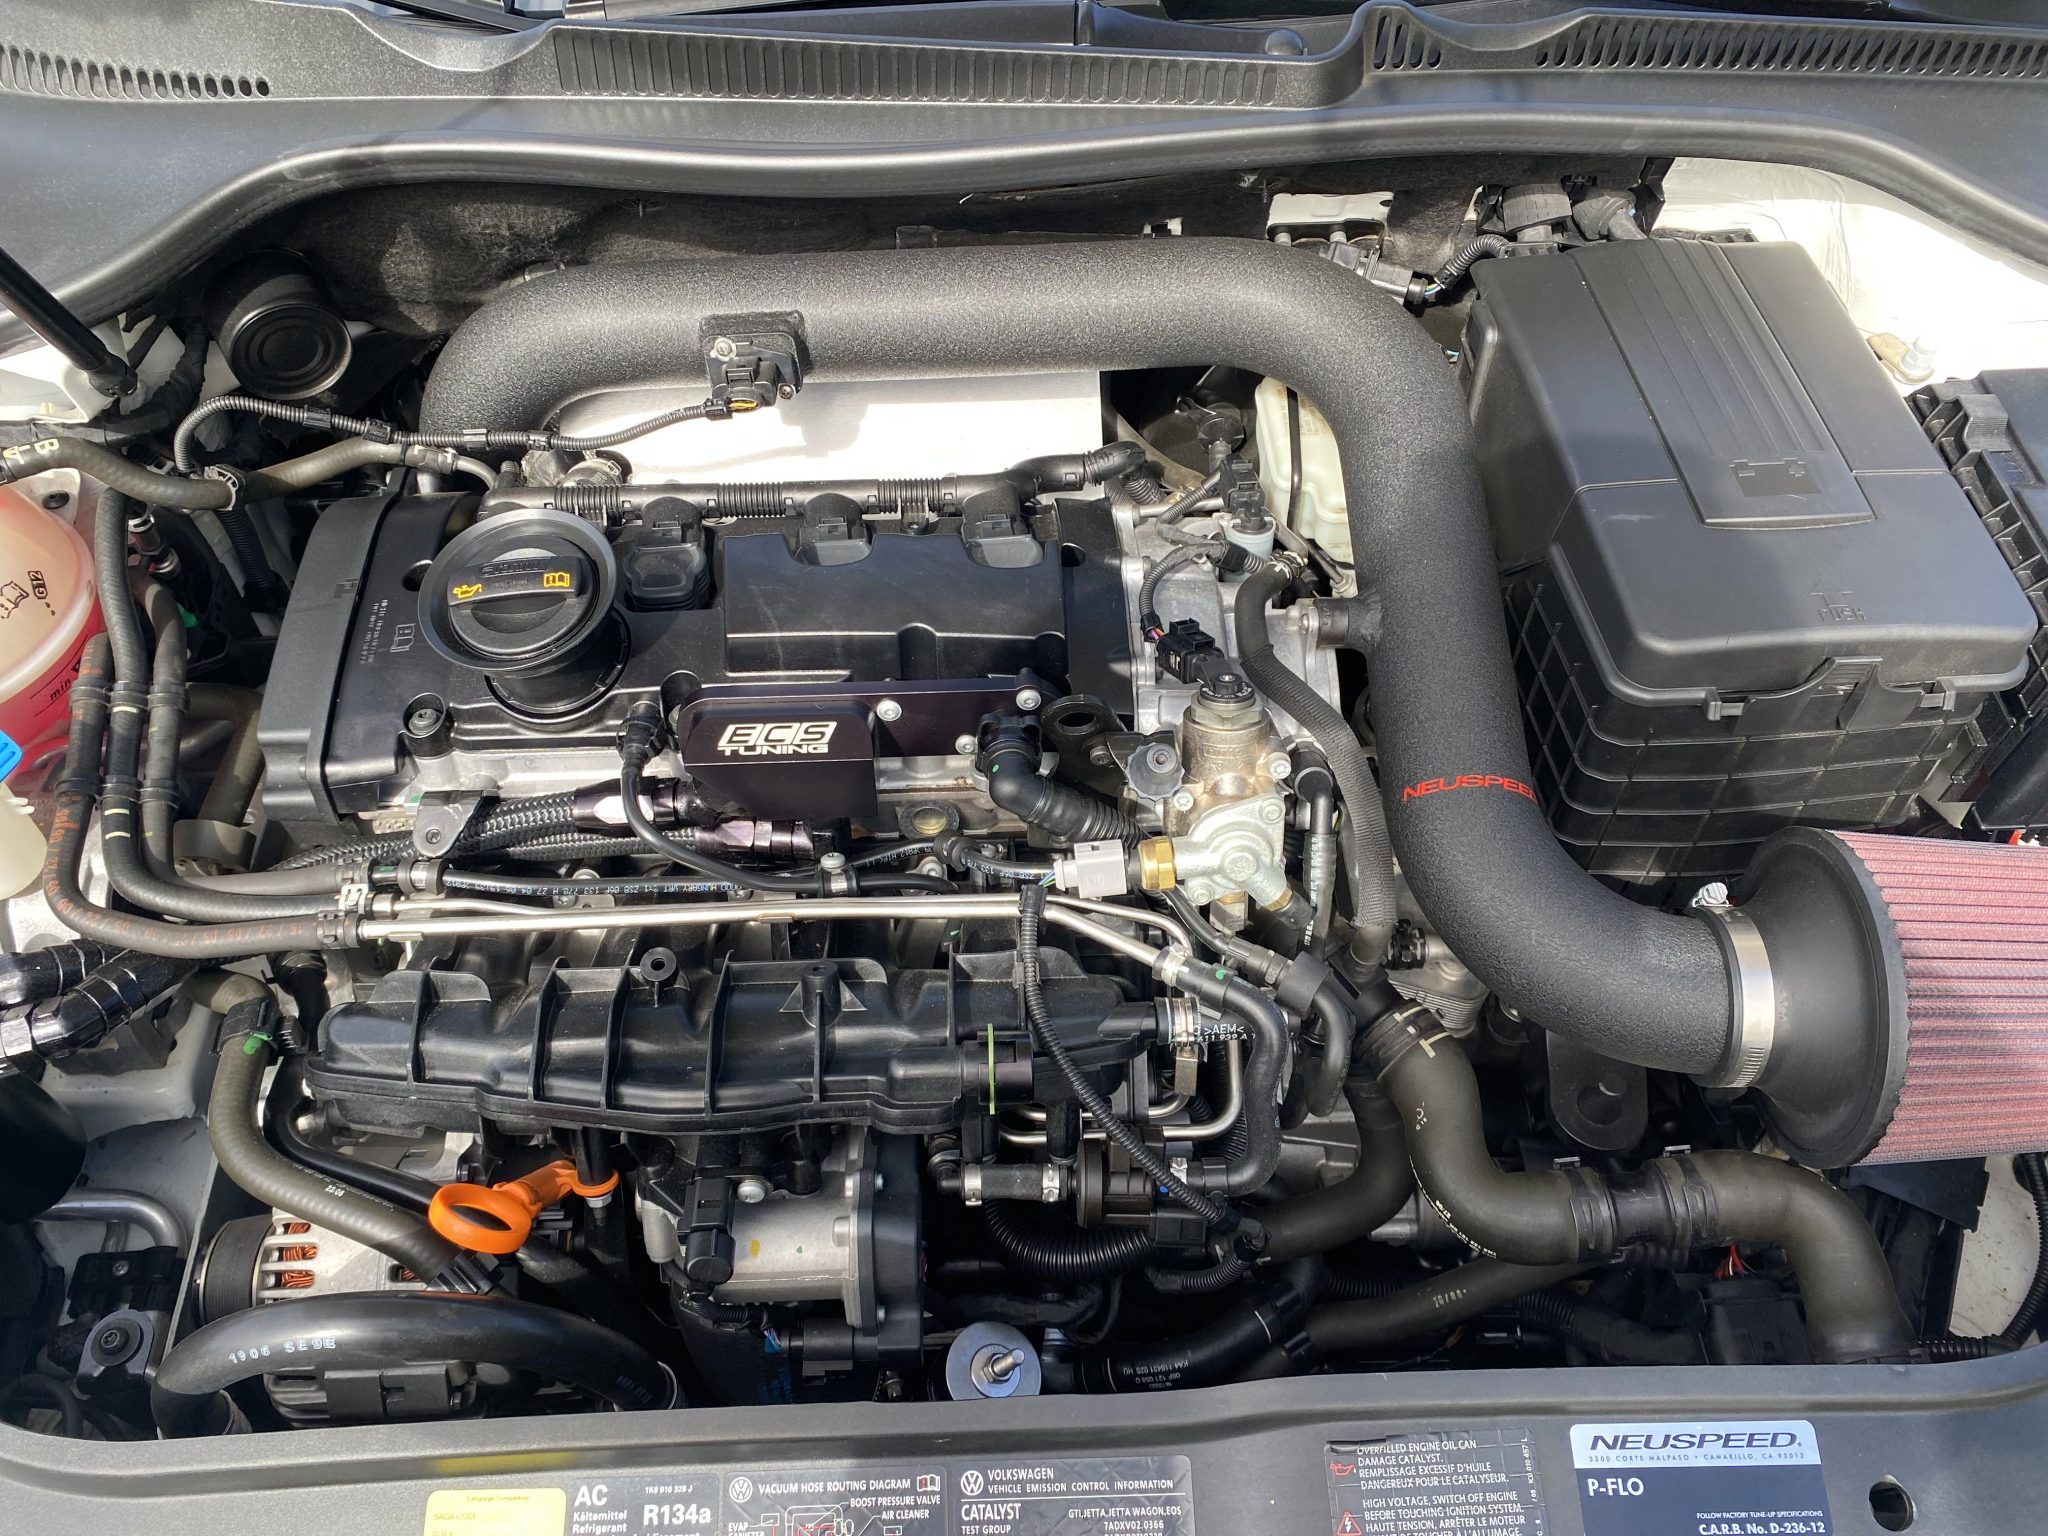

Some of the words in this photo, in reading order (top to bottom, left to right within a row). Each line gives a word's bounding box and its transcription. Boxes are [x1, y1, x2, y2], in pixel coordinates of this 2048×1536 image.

[30, 572, 46, 597] G12
[1817, 607, 1866, 621] PUSH
[50, 678, 70, 700] min
[718, 721, 838, 747] ECS
[718, 744, 829, 756] TUNING
[1356, 1443, 1407, 1455] OVERFILLED
[1408, 1441, 1441, 1452] ENGINE
[1442, 1440, 1458, 1450] OIL
[1458, 1440, 1477, 1450] CAN
[1358, 1455, 1398, 1466] DAMAGE
[1398, 1453, 1444, 1464] CATALYST.
[1616, 1454, 1644, 1462] CORTE
[987, 1468, 1054, 1481] VOLKSWAGEN
[1360, 1466, 1416, 1478] REMPLISSAGE
[1418, 1464, 1455, 1475] EXCESSIF
[1457, 1462, 1492, 1473] D'HUILE
[688, 1484, 693, 1492] J
[758, 1482, 798, 1494] VACUUM
[801, 1482, 824, 1493] HOSE
[826, 1480, 866, 1492] ROUTING
[870, 1478, 911, 1490] DIAGRAM
[988, 1484, 1022, 1494] VEHICLE
[1026, 1482, 1067, 1492] EMISSION
[1072, 1482, 1110, 1492] CONTROL
[1114, 1480, 1174, 1490] INFORMATION
[1361, 1478, 1414, 1490] DANGEREUX
[1416, 1476, 1440, 1487] POUR
[1441, 1475, 1452, 1486] LE
[1452, 1473, 1509, 1485] CATALYSEUR.
[1587, 1478, 1645, 1496] P-FLO
[574, 1484, 609, 1507] AC
[850, 1497, 876, 1508] BOOST
[878, 1496, 916, 1507] PRESSURE
[916, 1494, 940, 1505] VALVE
[1362, 1498, 1386, 1508] HIGH
[1388, 1496, 1430, 1507] VOLTAGE,
[1432, 1494, 1466, 1504] SWITCH
[1468, 1492, 1484, 1502] OFF
[1486, 1491, 1518, 1502] ENGINE
[573, 1510, 628, 1522] Kältemittel
[643, 1503, 712, 1526] R134a
[881, 1510, 895, 1520] AIR
[896, 1509, 930, 1520] CLEANER
[961, 1503, 1021, 1521] CATALYST
[1132, 1506, 1182, 1516] WAGON,EOS
[1364, 1510, 1396, 1520] BEFORE
[1397, 1506, 1444, 1518] TOUCHING
[1446, 1505, 1487, 1516] IGNITION
[1488, 1502, 1524, 1514] SYSTEM.
[1750, 1510, 1776, 1518] TUNE-UP
[1776, 1510, 1824, 1518] SPECIFICATIONS
[572, 1523, 628, 1535] Refrigerant
[728, 1522, 748, 1532] EVAP
[962, 1526, 980, 1535] TEST
[982, 1524, 1012, 1534] GROUP
[1104, 1520, 1164, 1530] 7ADXV02.0366
[1365, 1522, 1396, 1532] HAUTE
[1396, 1520, 1437, 1531] TENSION,
[1439, 1516, 1476, 1528] ARRÊTER
[1476, 1516, 1488, 1526] LE
[1490, 1515, 1526, 1526] MOTEUR
[1699, 1524, 1745, 1535] C.A.R.B.
[1746, 1523, 1768, 1534] No.
[1770, 1522, 1826, 1534] D-236-12
